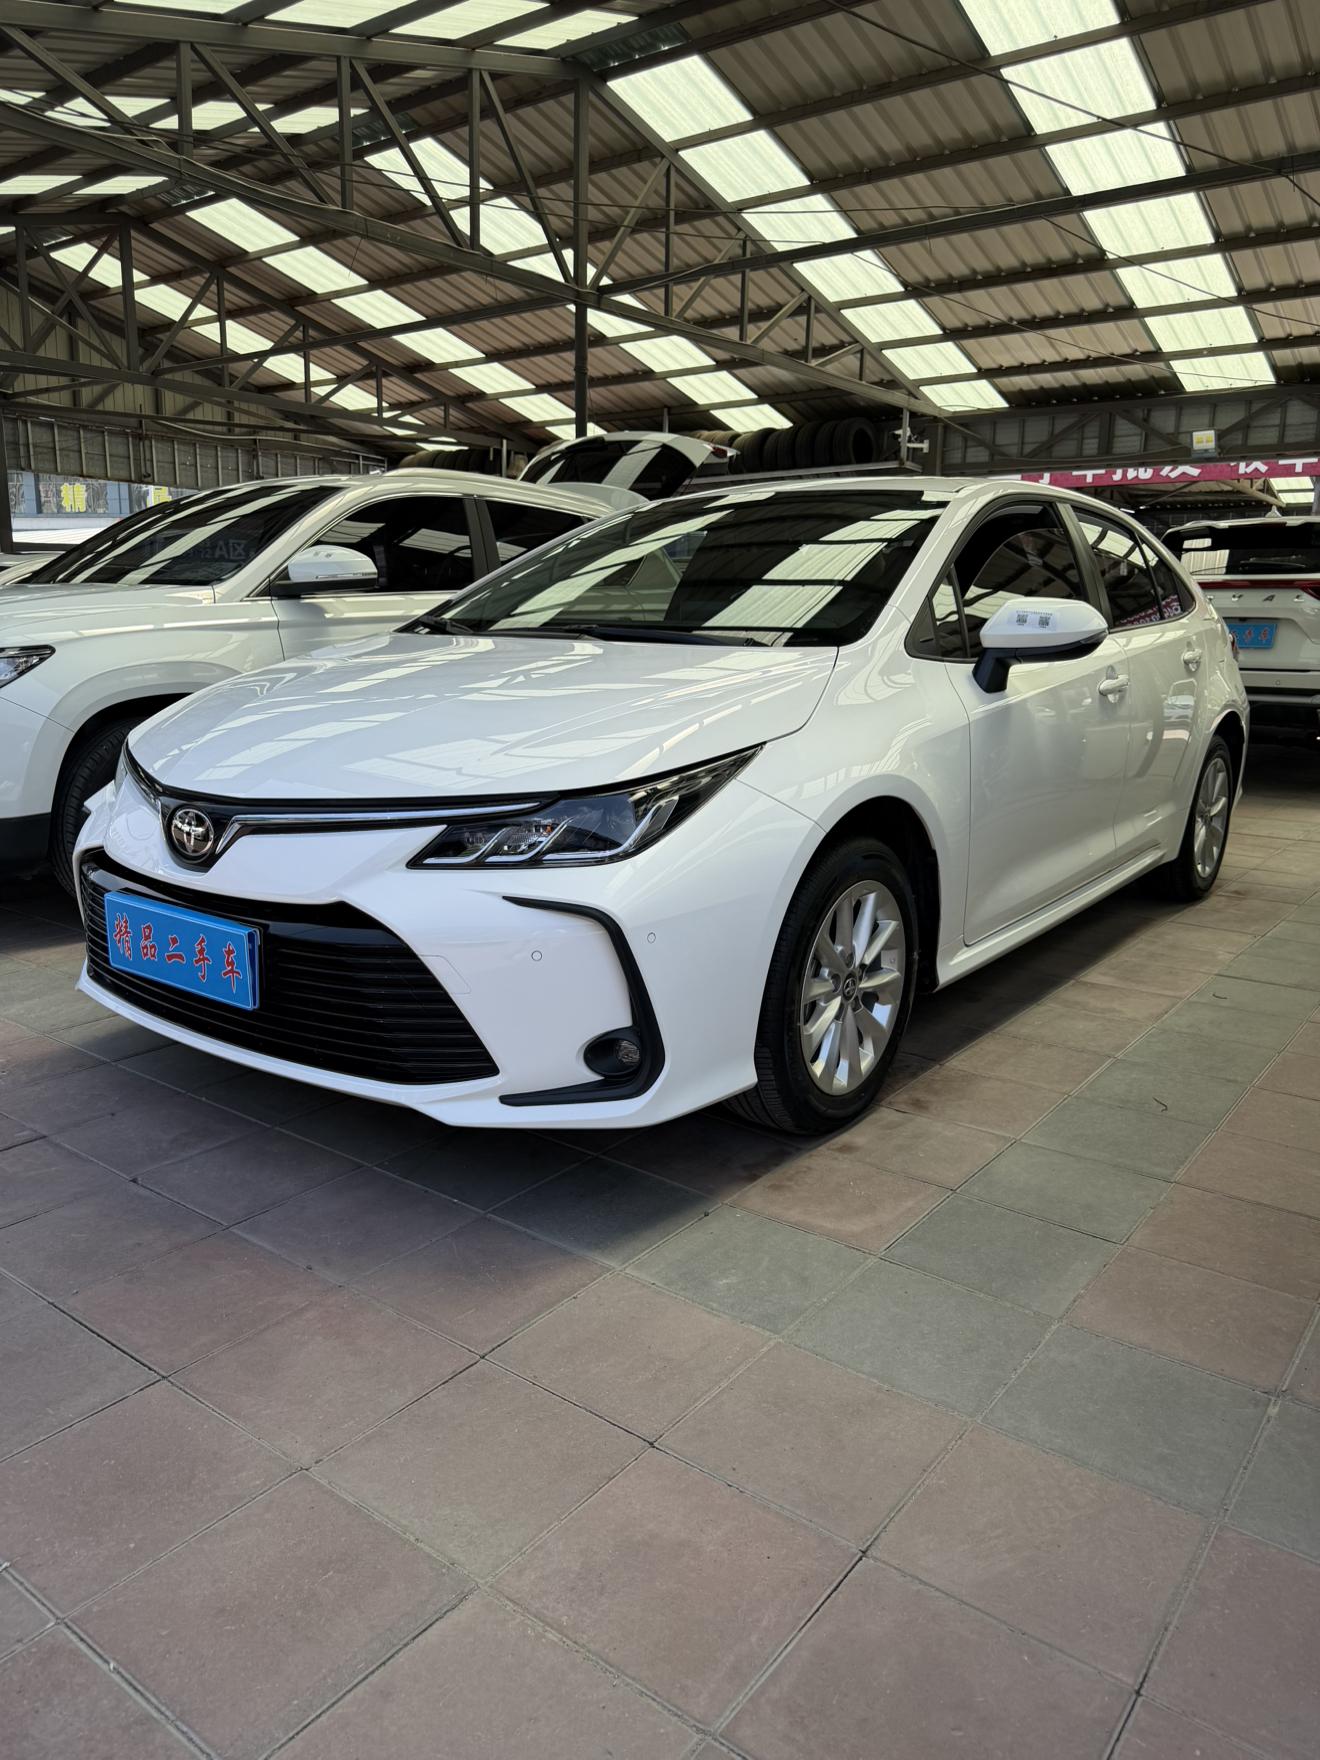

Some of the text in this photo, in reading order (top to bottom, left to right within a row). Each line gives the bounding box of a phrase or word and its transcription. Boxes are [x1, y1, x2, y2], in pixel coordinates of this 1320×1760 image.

[60, 483, 87, 512] 精
[113, 912, 243, 995] 精品二手车
